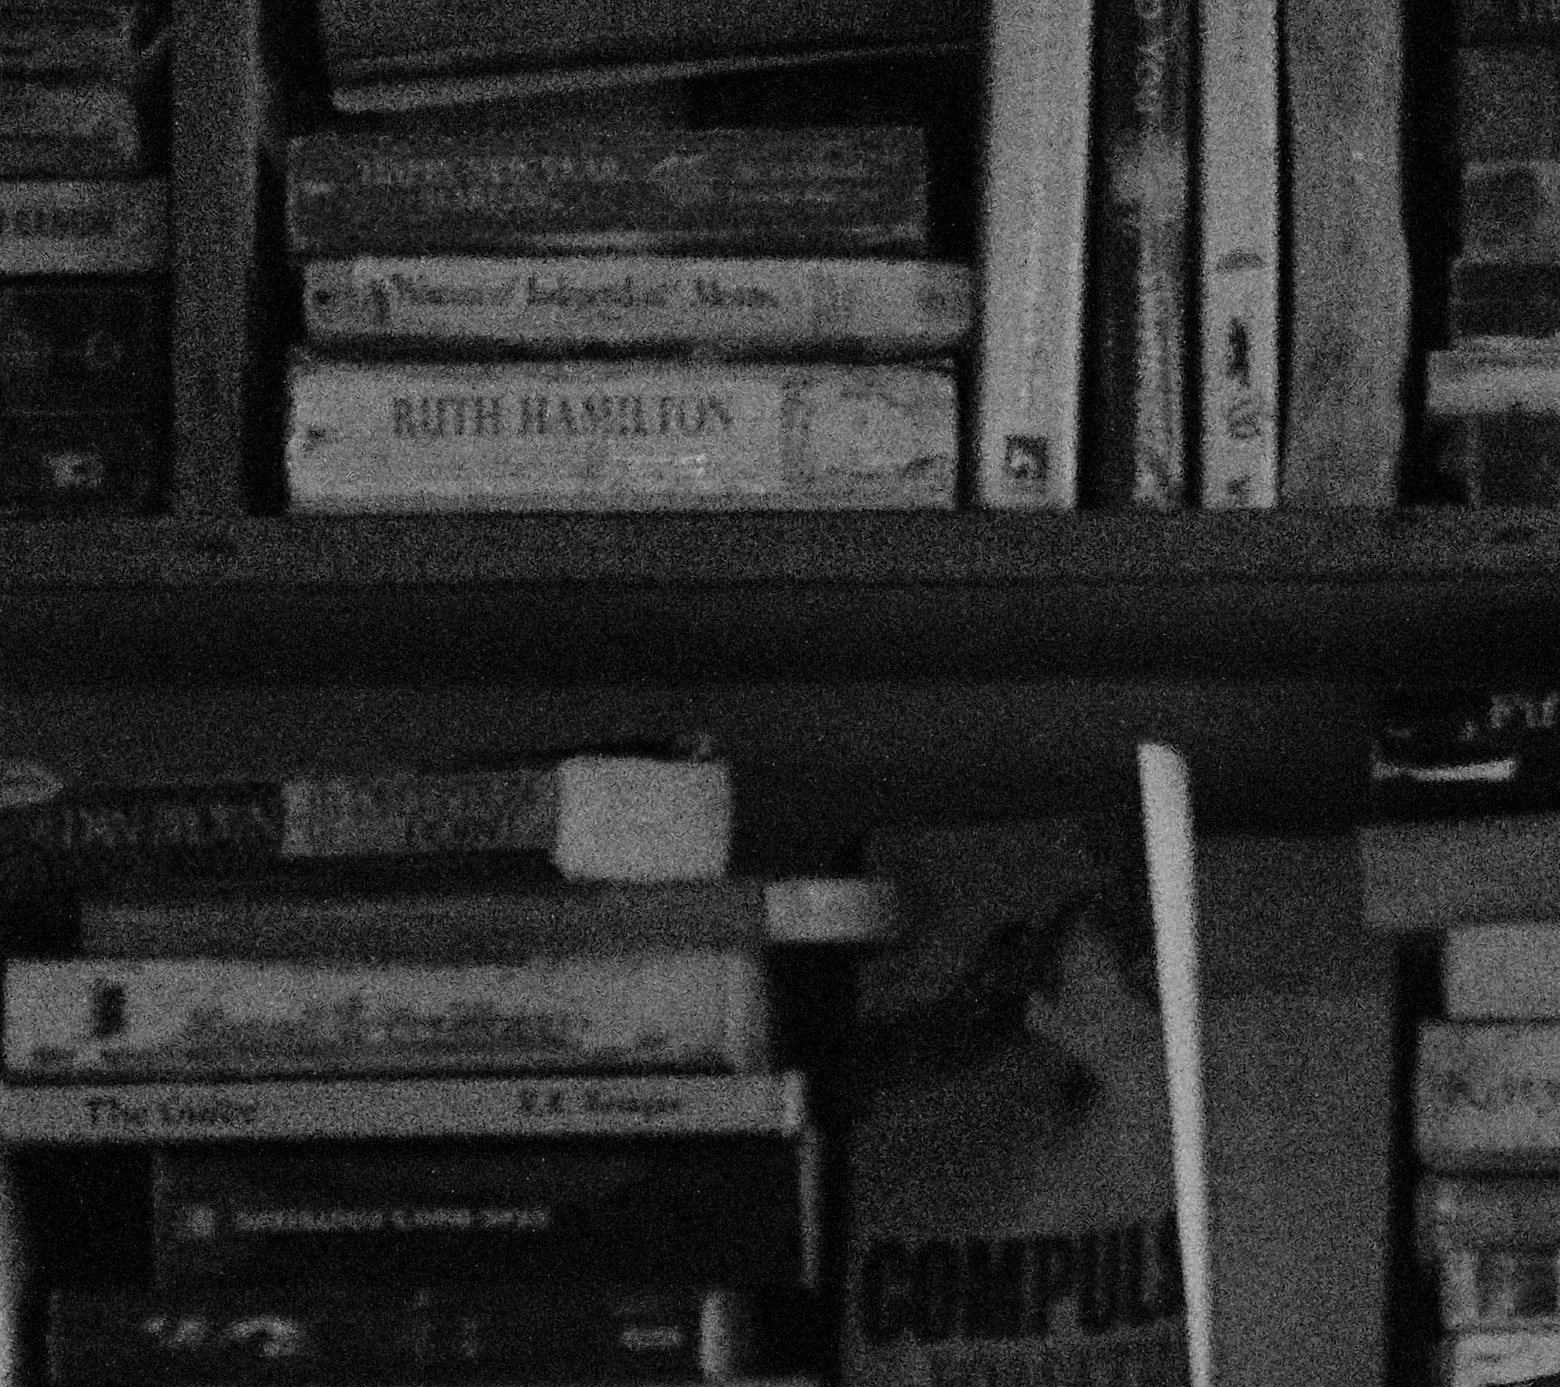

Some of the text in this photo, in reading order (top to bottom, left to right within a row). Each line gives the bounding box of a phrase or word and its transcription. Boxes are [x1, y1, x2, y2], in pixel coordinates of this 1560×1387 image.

[391, 397, 736, 438] RUTH HAMILTON
[860, 1212, 1182, 1348] COMPULS
